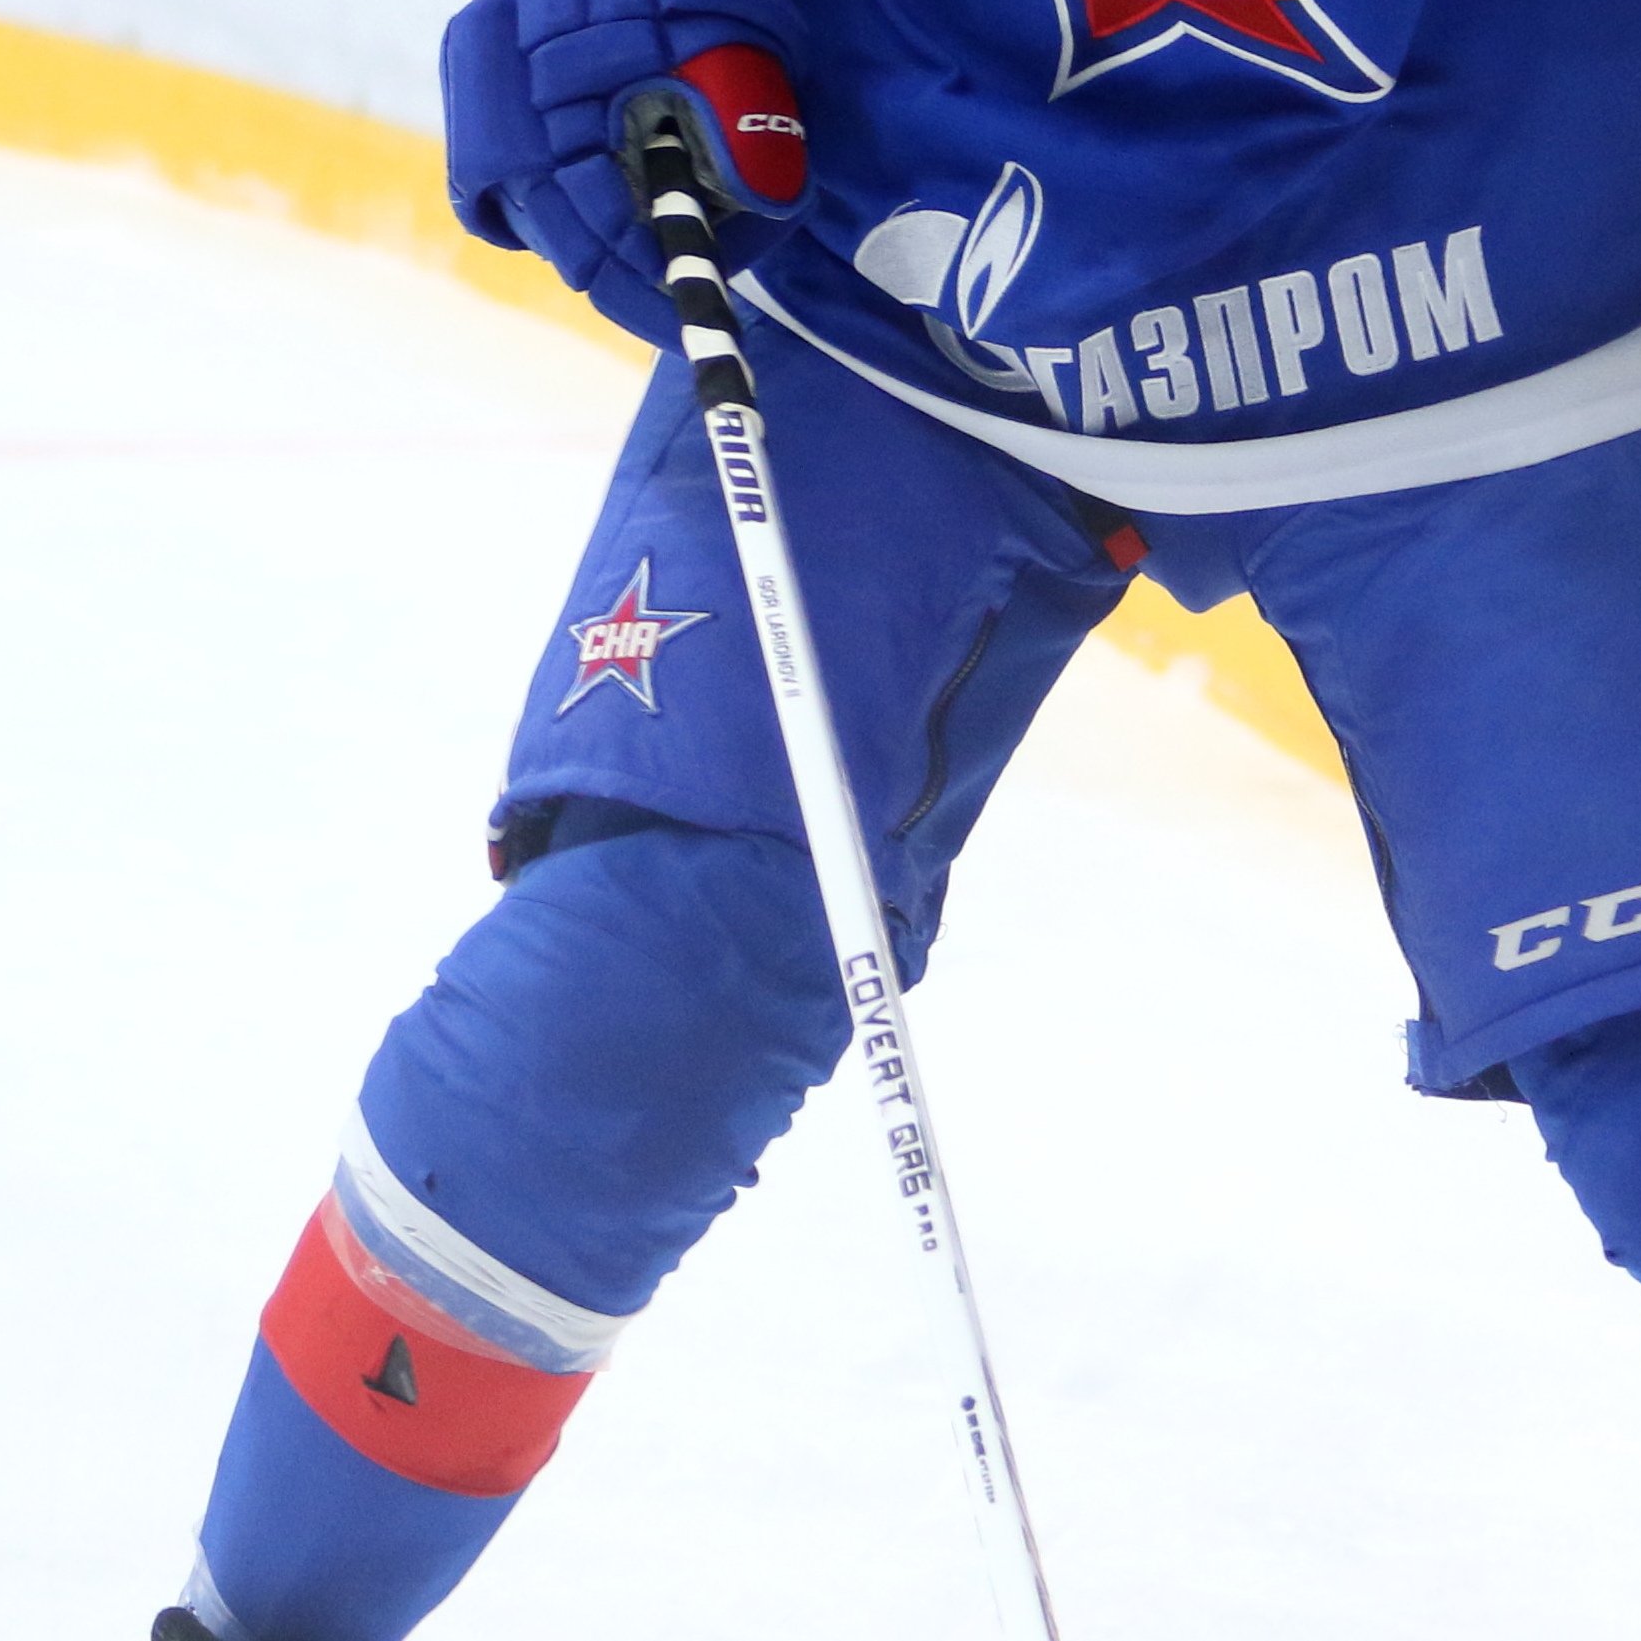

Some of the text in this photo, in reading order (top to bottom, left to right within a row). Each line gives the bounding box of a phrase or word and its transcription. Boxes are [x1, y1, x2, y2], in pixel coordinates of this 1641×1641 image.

[1024, 226, 1504, 435] ГАЗПРОМ
[845, 951, 913, 1106] COVERT
[914, 1204, 939, 1252] PRO
